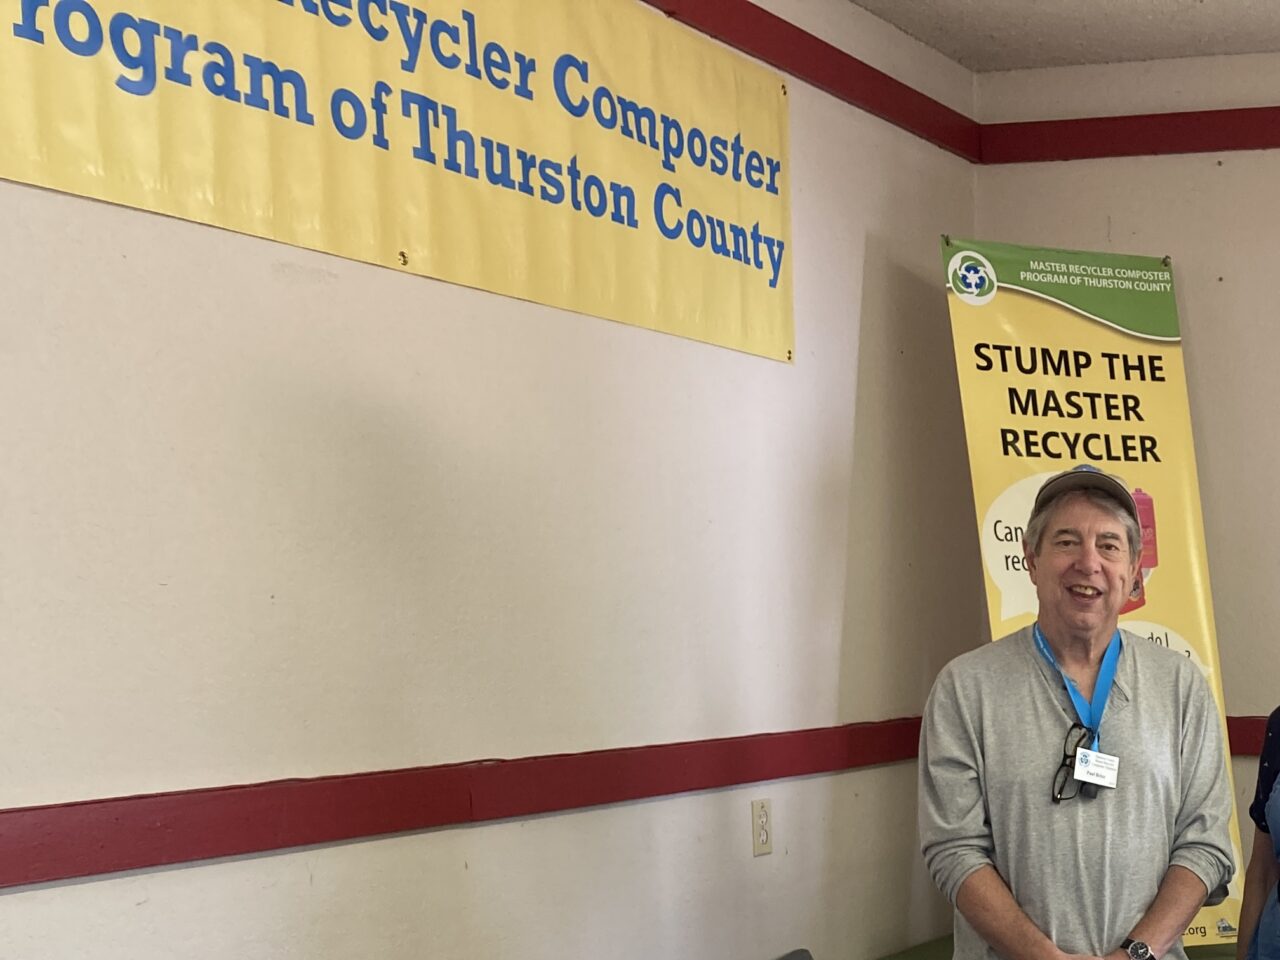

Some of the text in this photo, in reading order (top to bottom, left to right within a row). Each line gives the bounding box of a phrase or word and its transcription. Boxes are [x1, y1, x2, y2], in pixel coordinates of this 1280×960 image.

[276, 0, 781, 196] ecycler Composter
[331, 81, 393, 150] of
[401, 89, 639, 229] Thurston
[653, 182, 785, 288] County
[1020, 271, 1172, 292] PROGRAM OF THURSTON COUNTY
[1030, 261, 1170, 280] MASTER RECYCLER COMPOSTER
[974, 342, 1166, 382] STUMP THE
[1007, 386, 1145, 422] MASTER
[1000, 428, 1162, 463] RECYCLER
[993, 519, 1024, 542] Can
